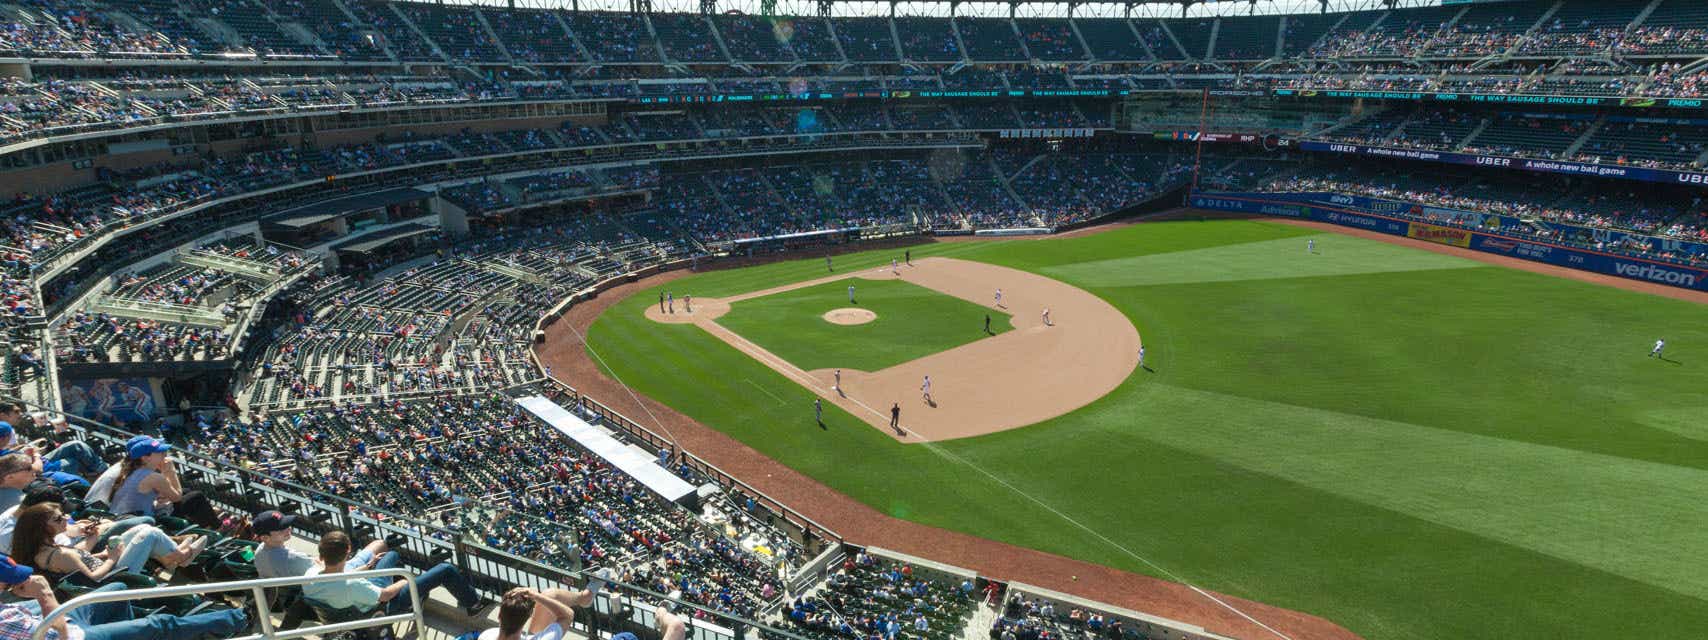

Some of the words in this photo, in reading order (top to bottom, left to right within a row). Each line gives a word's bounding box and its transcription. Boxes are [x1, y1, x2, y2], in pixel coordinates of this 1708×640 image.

[1667, 99, 1701, 107] PREMIO
[1330, 144, 1357, 153] UBER
[1476, 156, 1511, 166] UBER
[1533, 161, 1560, 170] whole
[1581, 164, 1597, 173] ball
[1599, 168, 1625, 176] game
[1207, 199, 1243, 208] DELTA
[1616, 262, 1695, 286] verizon
